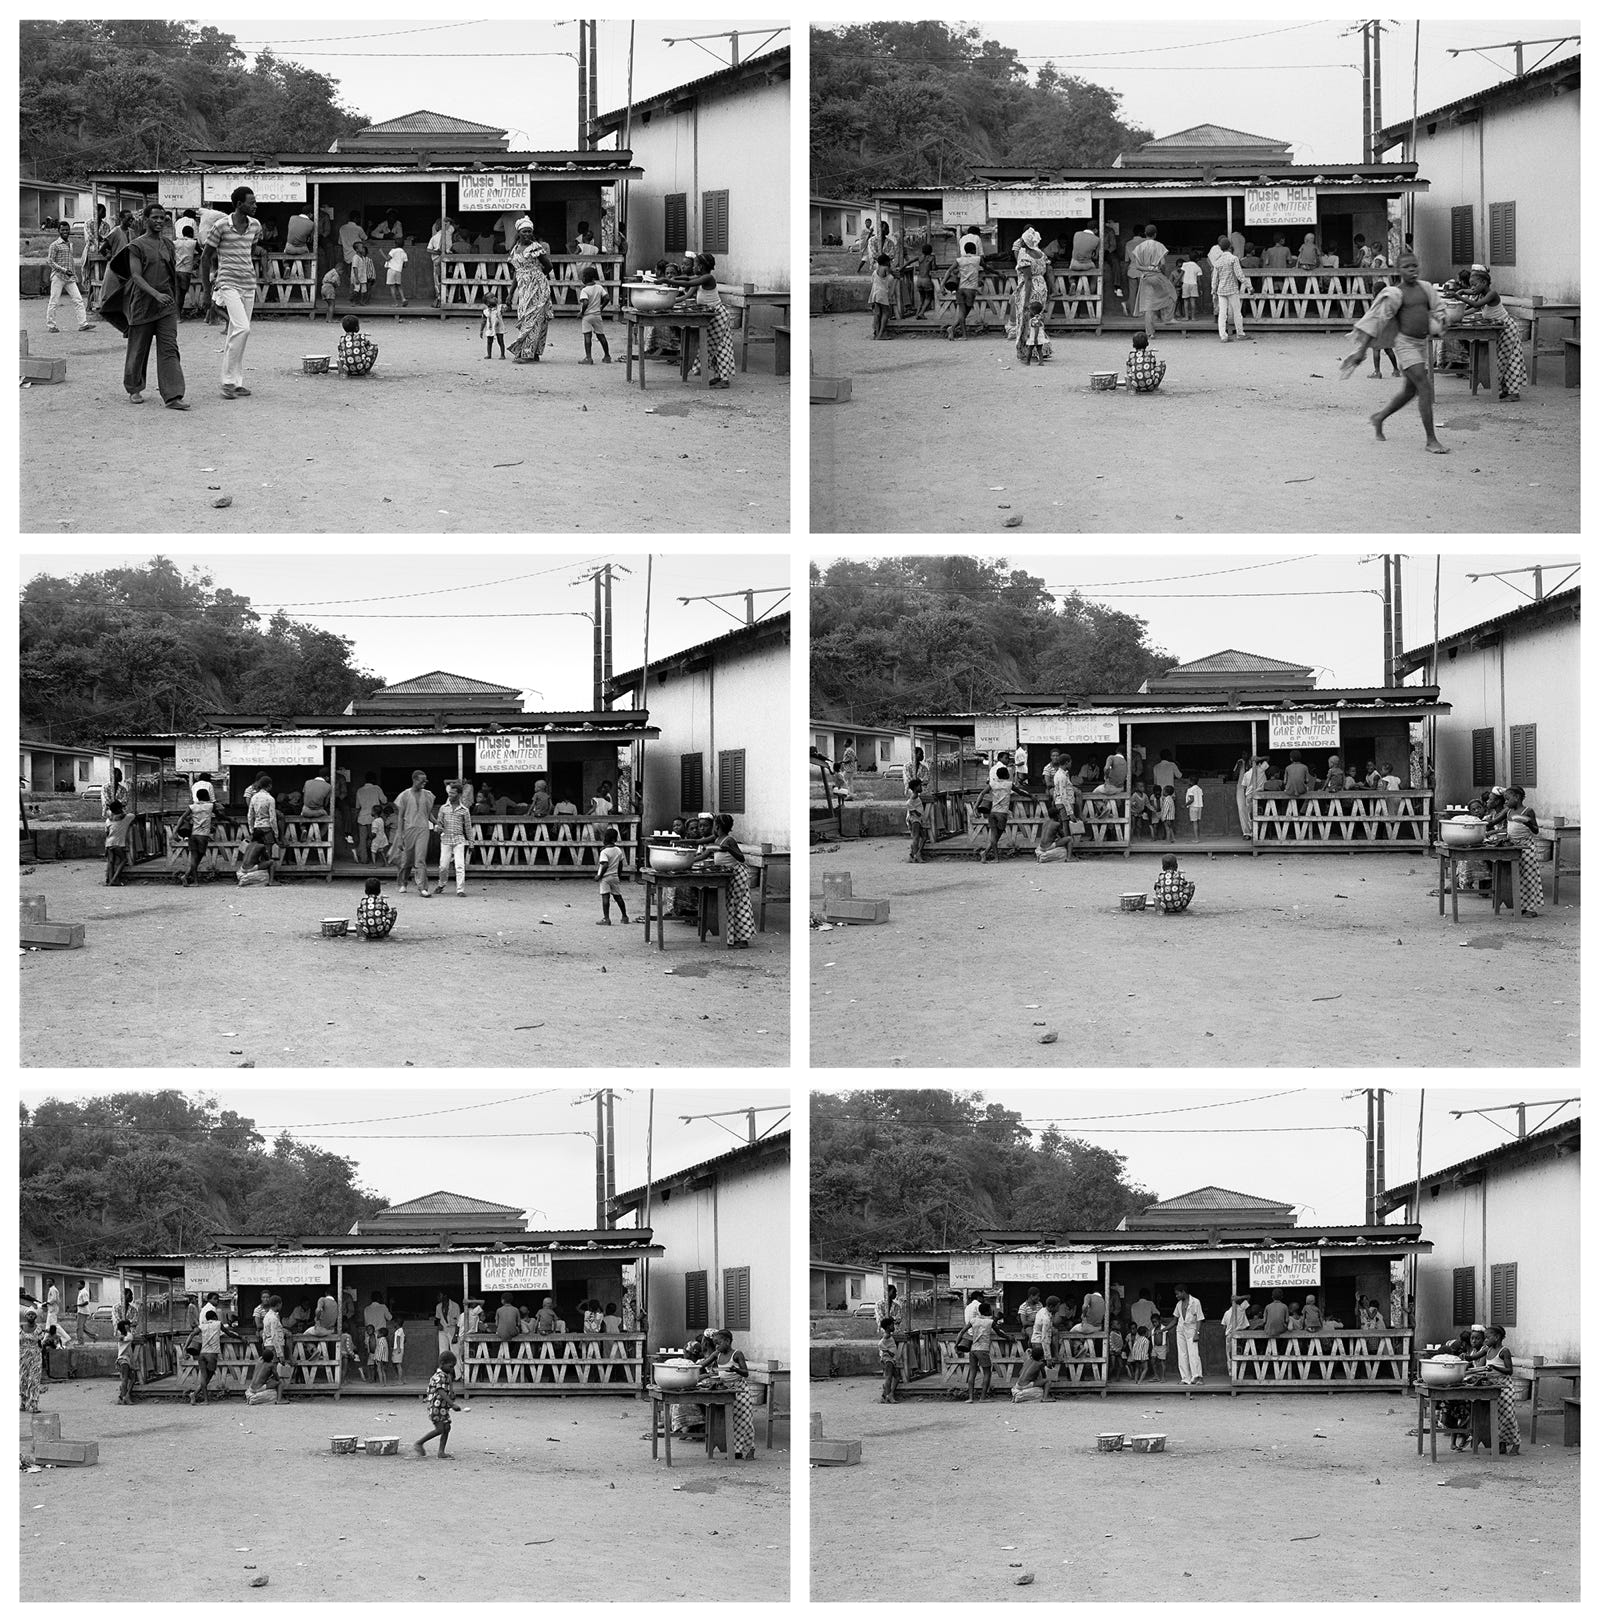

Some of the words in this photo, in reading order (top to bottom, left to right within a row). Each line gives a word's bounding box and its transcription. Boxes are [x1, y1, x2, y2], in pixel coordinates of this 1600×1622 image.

[462, 174, 494, 188] Music
[463, 188, 485, 198] GARE
[487, 188, 526, 198] ROUTIERE
[1250, 202, 1270, 212] GARE
[1272, 713, 1303, 726] Music
[1273, 726, 1294, 735] GARE
[1296, 726, 1335, 735] ROUTIERE
[479, 736, 510, 749] Music
[480, 749, 501, 759] GARE
[504, 749, 543, 759] ROUTIERE
[484, 1255, 515, 1268] Music
[1252, 1251, 1284, 1264] Music
[485, 1268, 506, 1278] GARE
[508, 1268, 548, 1277] ROUTIERE
[1254, 1264, 1275, 1274] GARE
[1277, 1264, 1316, 1273] ROUTIERE
